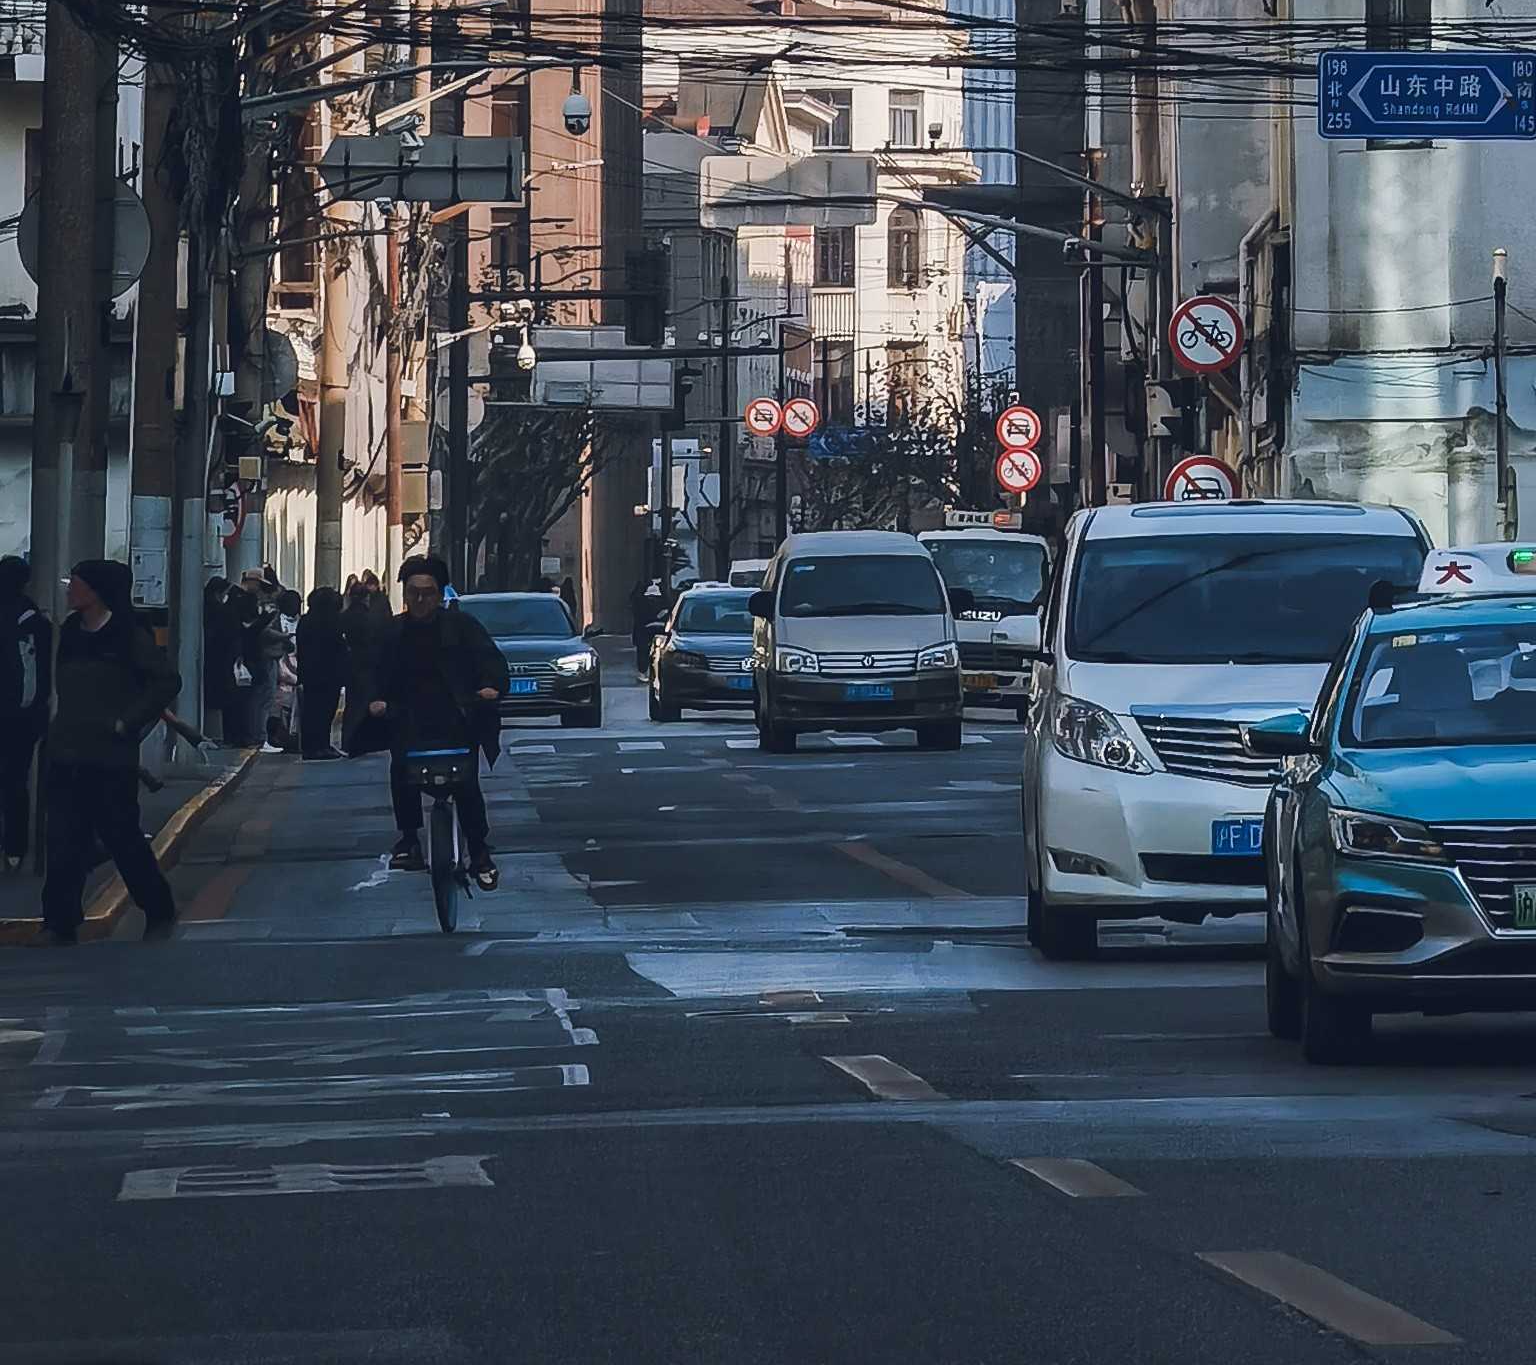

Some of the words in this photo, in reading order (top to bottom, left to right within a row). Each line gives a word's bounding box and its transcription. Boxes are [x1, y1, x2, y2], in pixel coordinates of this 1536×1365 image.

[1327, 59, 1348, 76] 198
[1512, 60, 1533, 78] 180
[1328, 80, 1343, 97] 北
[1380, 73, 1482, 98] 山东中路
[1515, 81, 1533, 100] 南
[1382, 102, 1440, 118] Shandong
[1327, 112, 1352, 129] 255
[1514, 115, 1535, 133] 145
[1434, 560, 1473, 585] 大
